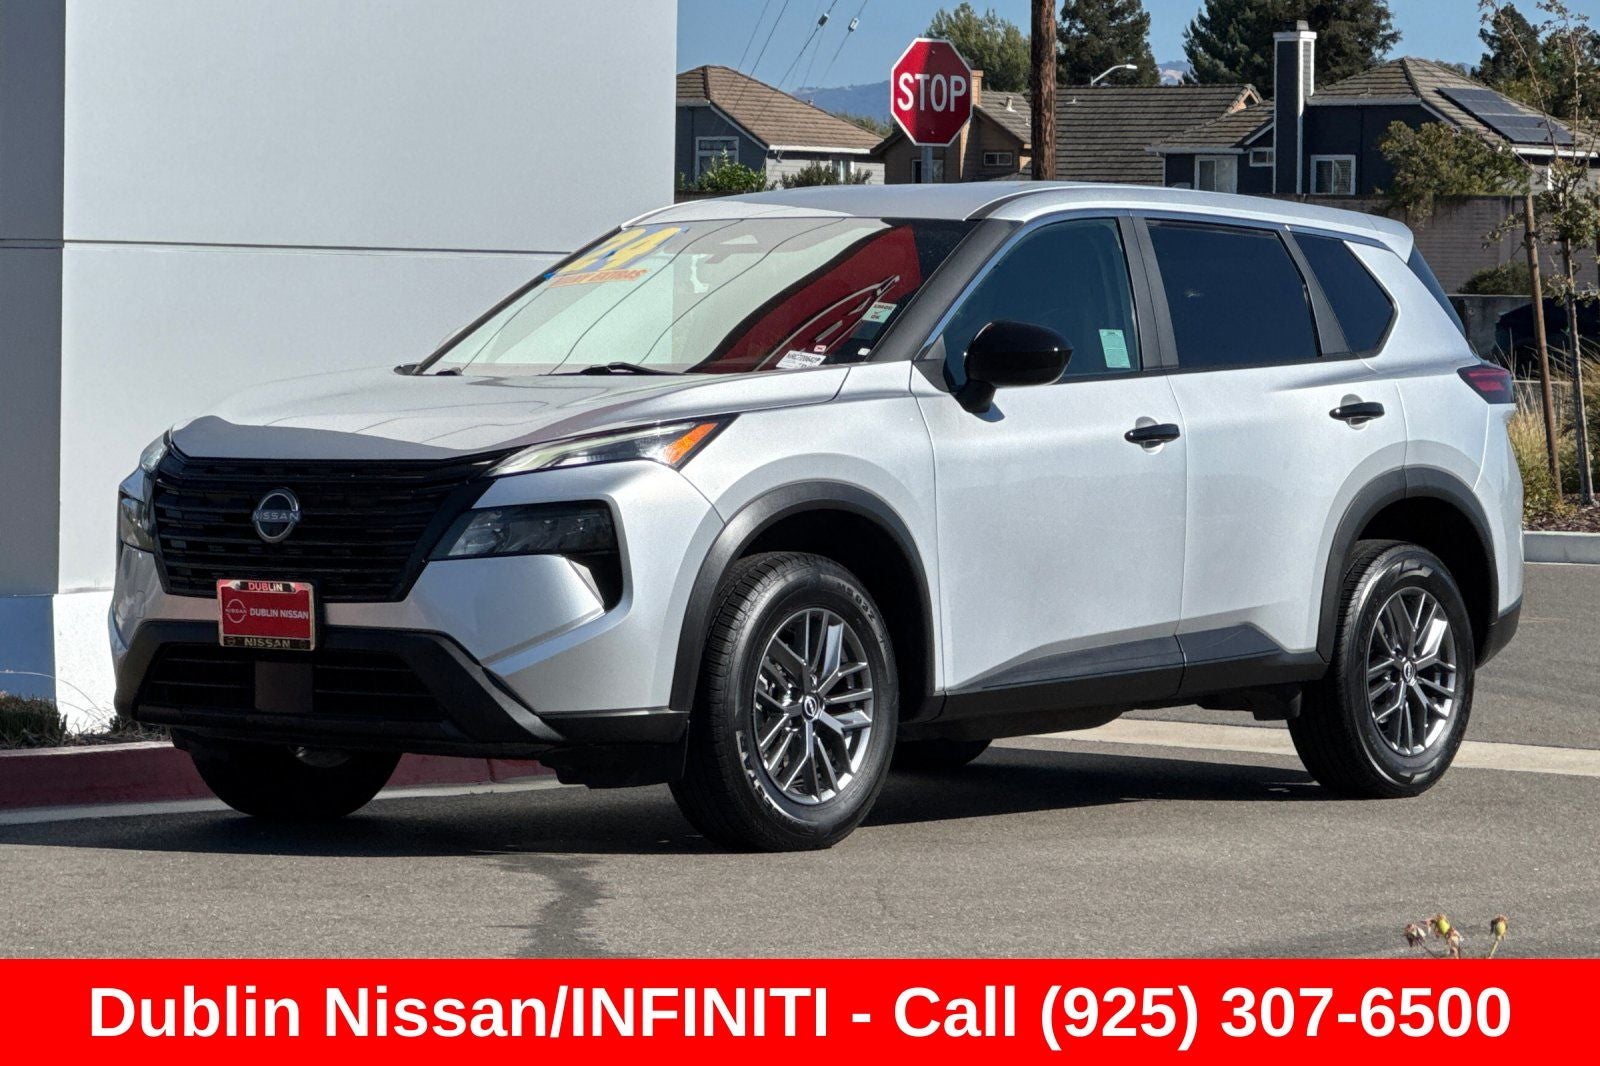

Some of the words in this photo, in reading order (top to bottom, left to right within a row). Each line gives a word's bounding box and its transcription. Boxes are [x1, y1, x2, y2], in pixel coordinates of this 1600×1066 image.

[897, 72, 967, 112] STOP
[254, 510, 300, 521] NISSAN
[248, 582, 283, 592] DUBLIN
[249, 607, 279, 618] DUBLIN
[280, 610, 309, 620] NISSAN
[244, 637, 291, 648] NISSAN
